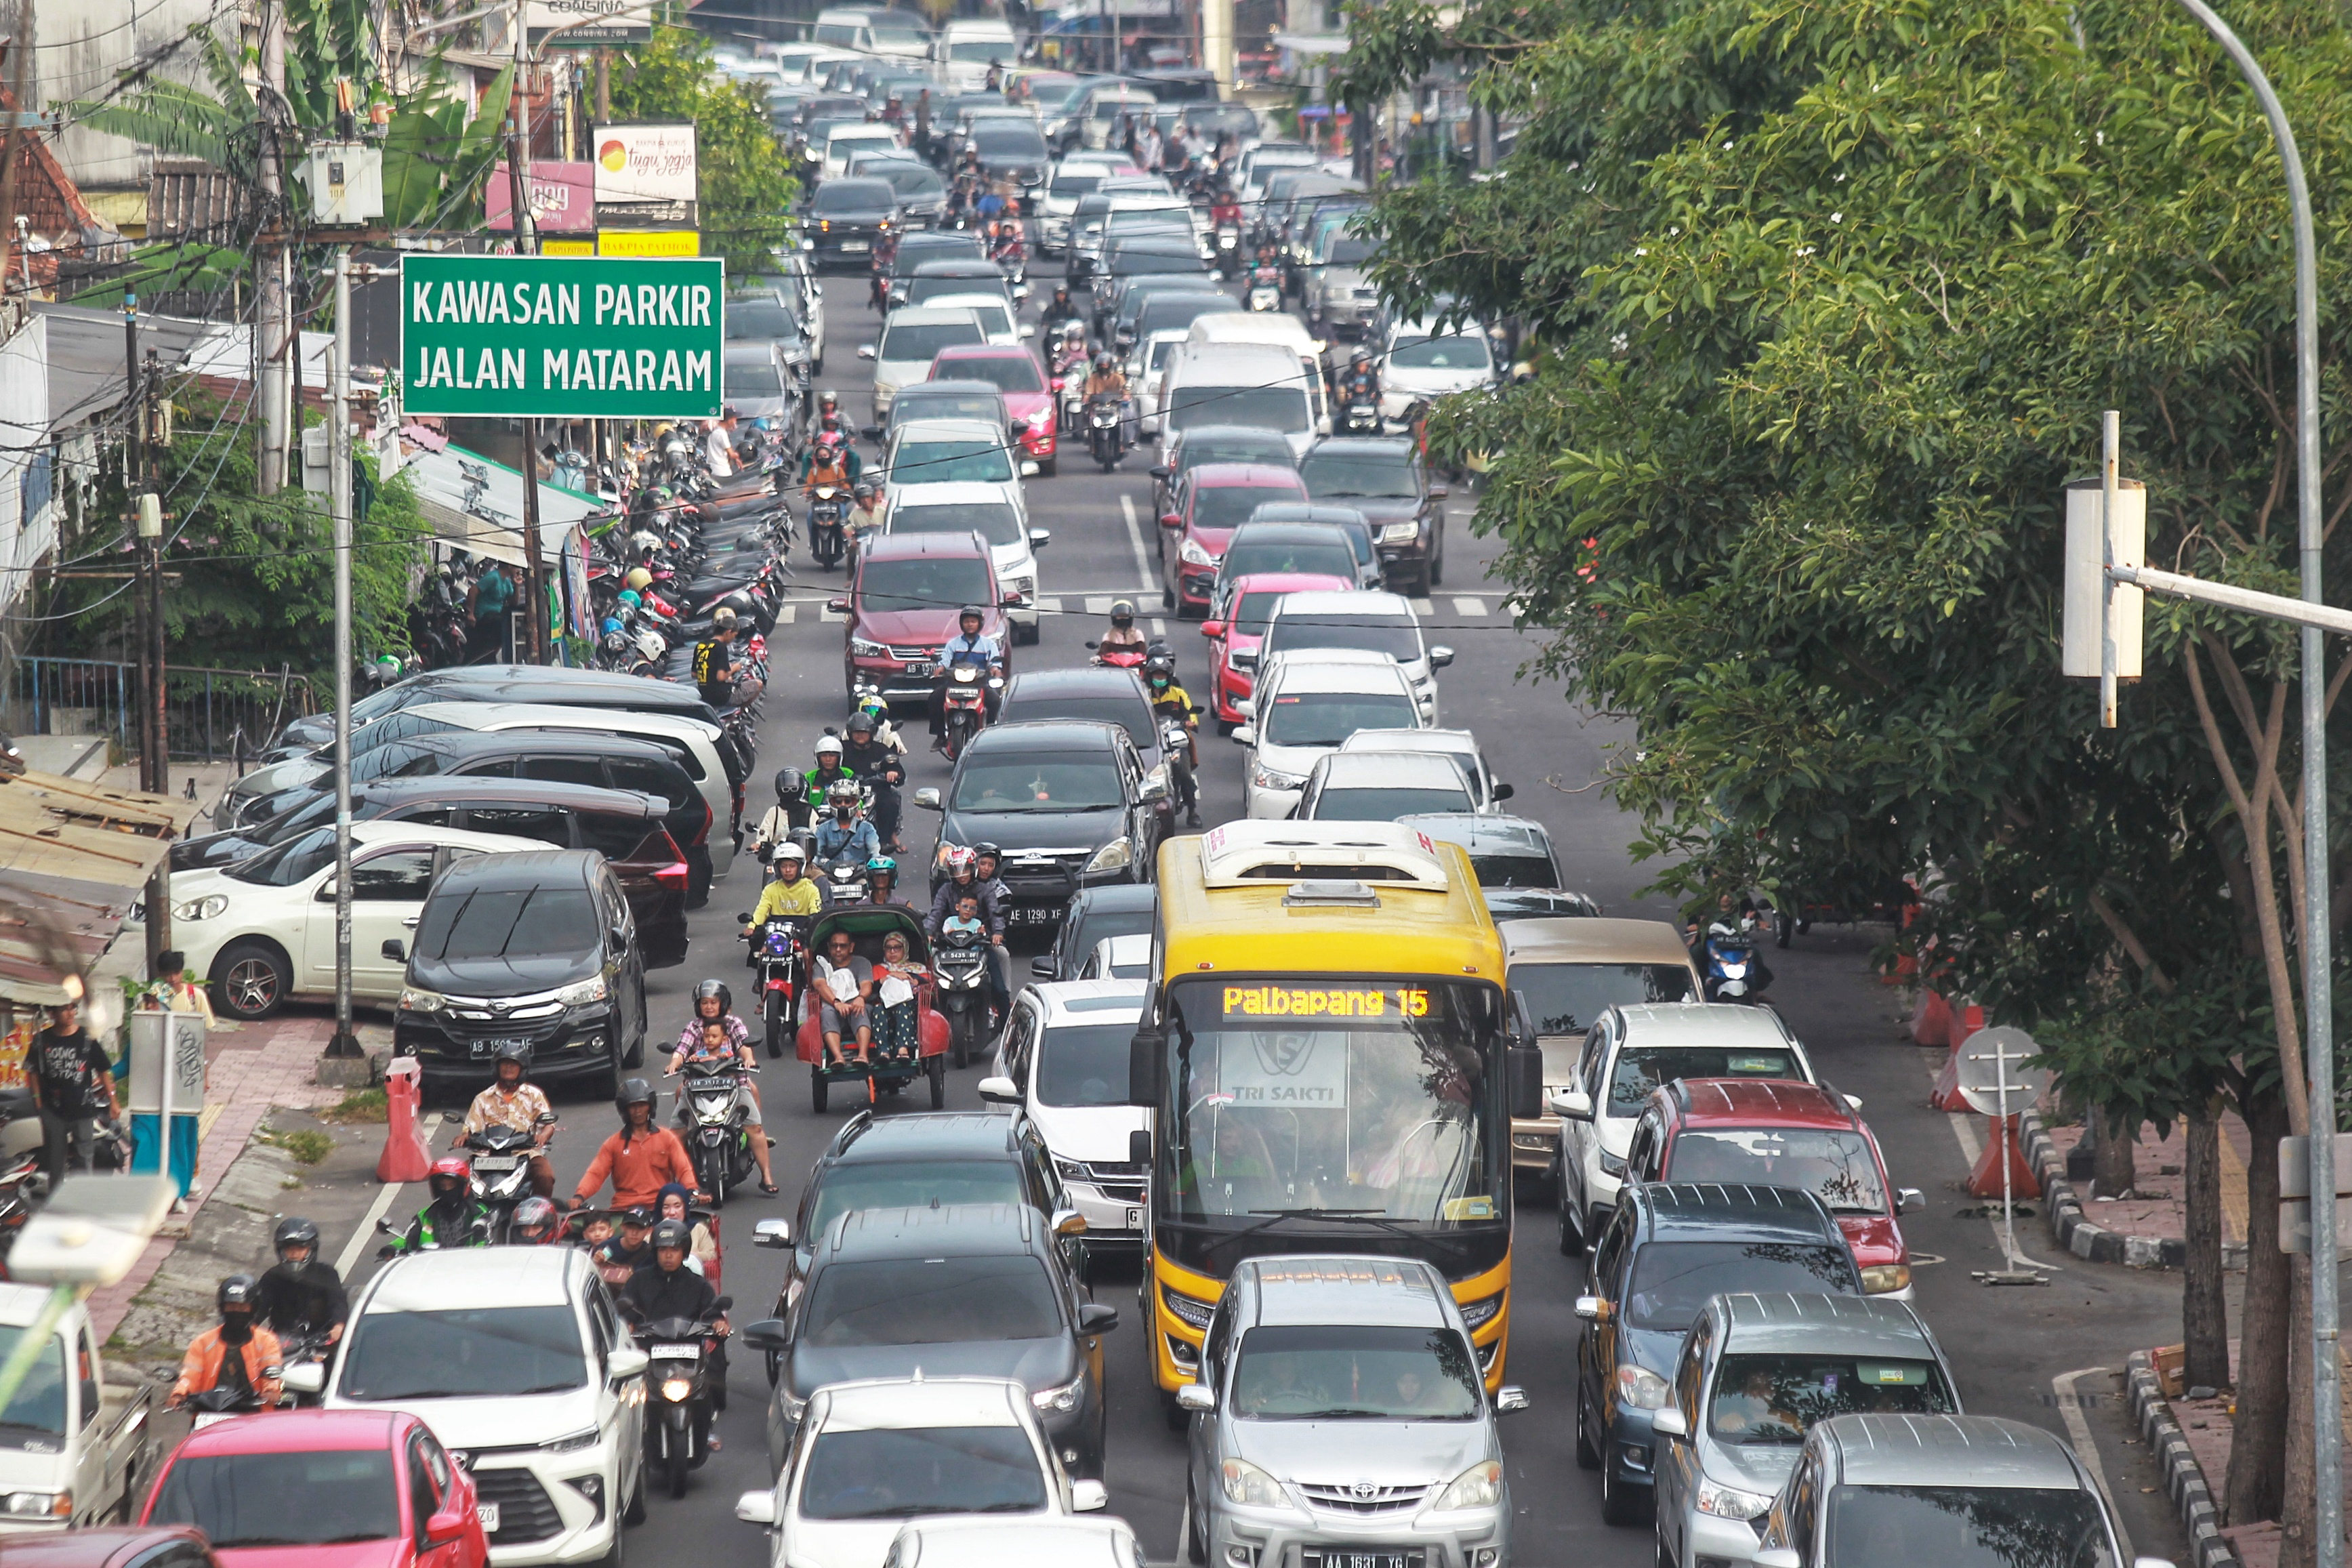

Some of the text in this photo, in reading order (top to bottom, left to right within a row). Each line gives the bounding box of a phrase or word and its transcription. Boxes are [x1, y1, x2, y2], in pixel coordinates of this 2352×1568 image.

[629, 147, 693, 177] tugu jogja
[604, 242, 692, 253] BAKPIA PATHOK
[413, 280, 711, 327] KAWASAN PARKIR
[413, 346, 711, 392] JALAN MATARAM
[780, 900, 799, 909] GAP
[1010, 909, 1062, 921] AE 1290 XF
[1223, 987, 1429, 1016] Palbapang 15
[472, 1039, 484, 1053] AB
[1232, 1086, 1334, 1101] TRI SAKTI
[1130, 1210, 1137, 1222] G
[1327, 1554, 1342, 1568] AA
[1350, 1555, 1376, 1568] 1631
